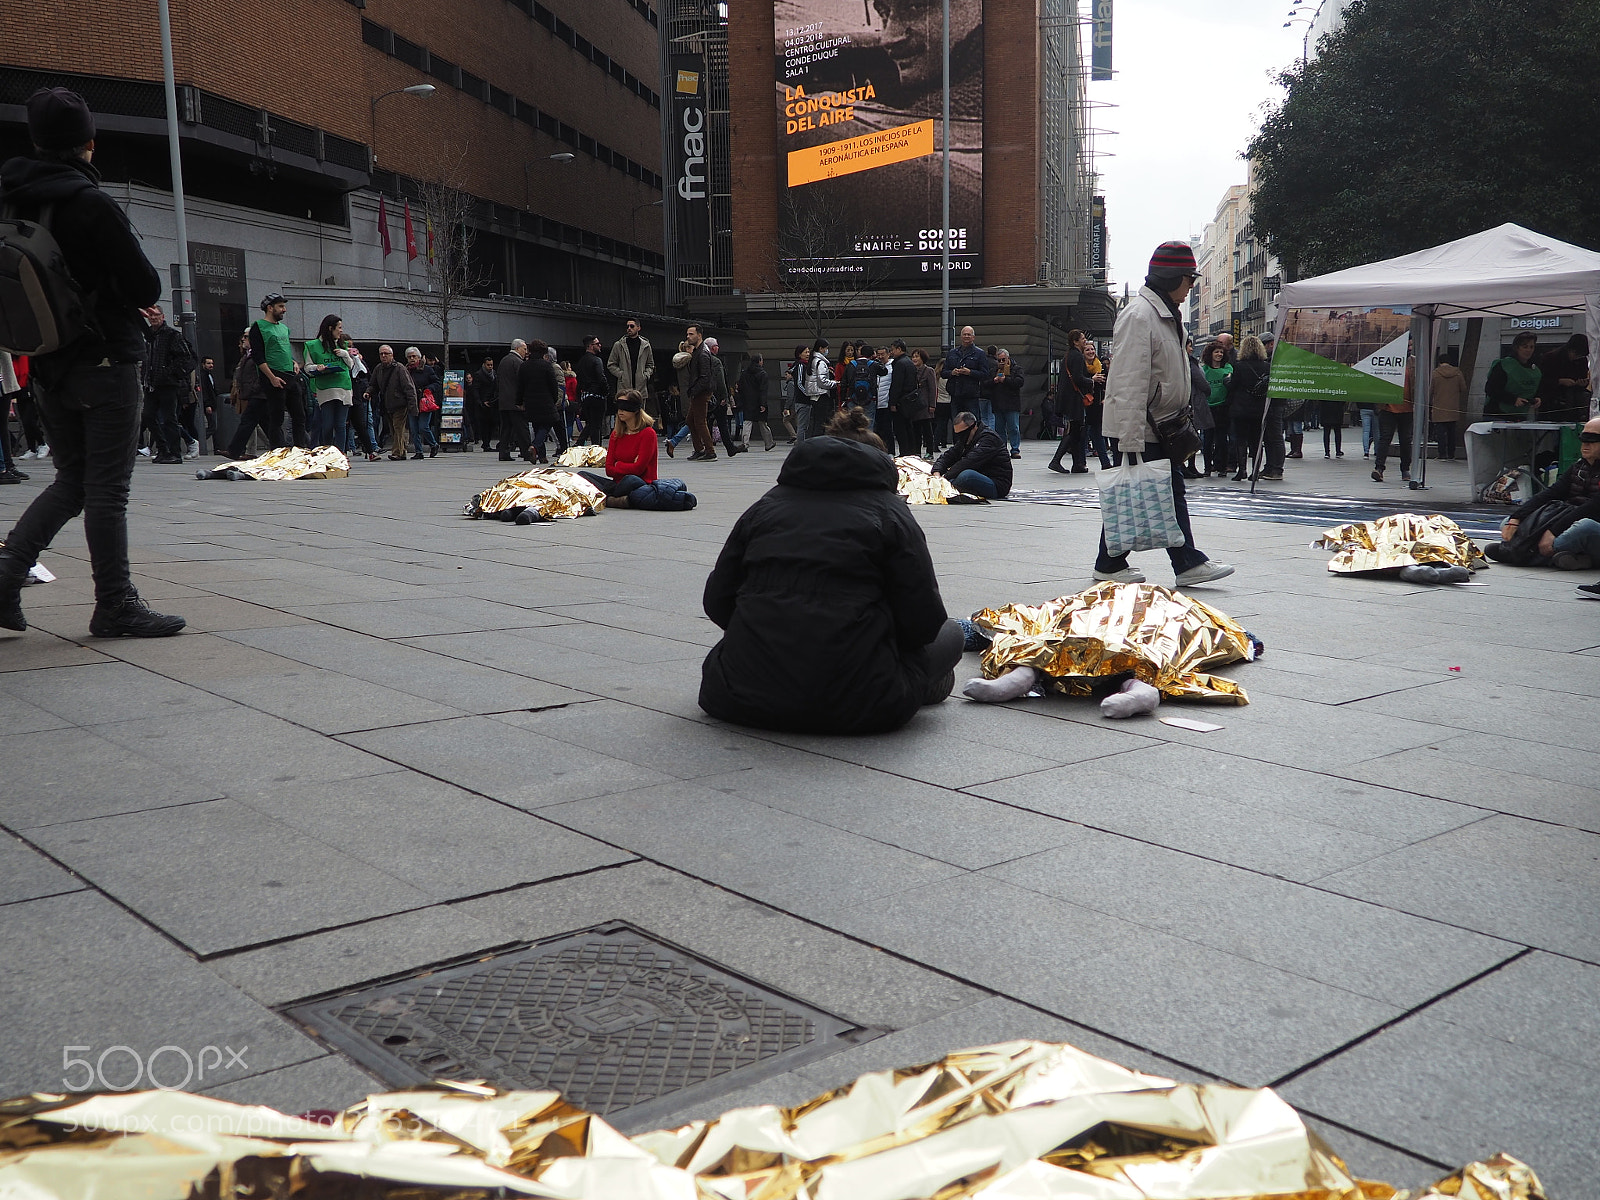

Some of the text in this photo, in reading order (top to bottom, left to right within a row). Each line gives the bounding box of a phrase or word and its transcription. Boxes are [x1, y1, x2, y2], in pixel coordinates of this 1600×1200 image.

[785, 22, 823, 37] 13.12.2017
[1093, 0, 1112, 48] fna
[785, 32, 823, 47] 04.03.2018
[785, 35, 852, 58] CENTRO CULTURAL
[785, 48, 839, 68] CONDE DUQUE
[785, 67, 804, 78] SALA
[785, 84, 806, 102] LA
[785, 84, 876, 118] CONQUISTA
[786, 106, 855, 135] DEL AIRE
[819, 146, 836, 157] 1909
[859, 137, 874, 147] LOS
[901, 128, 912, 138] DE
[912, 126, 923, 135] LA
[819, 139, 909, 167] AERONÁUTICA EN ESPAÑA
[678, 107, 706, 200] fnac
[1092, 224, 1101, 272] OTOGRAFIA
[195, 262, 238, 278] EXPERIENCE
[1510, 316, 1560, 330] Desigual
